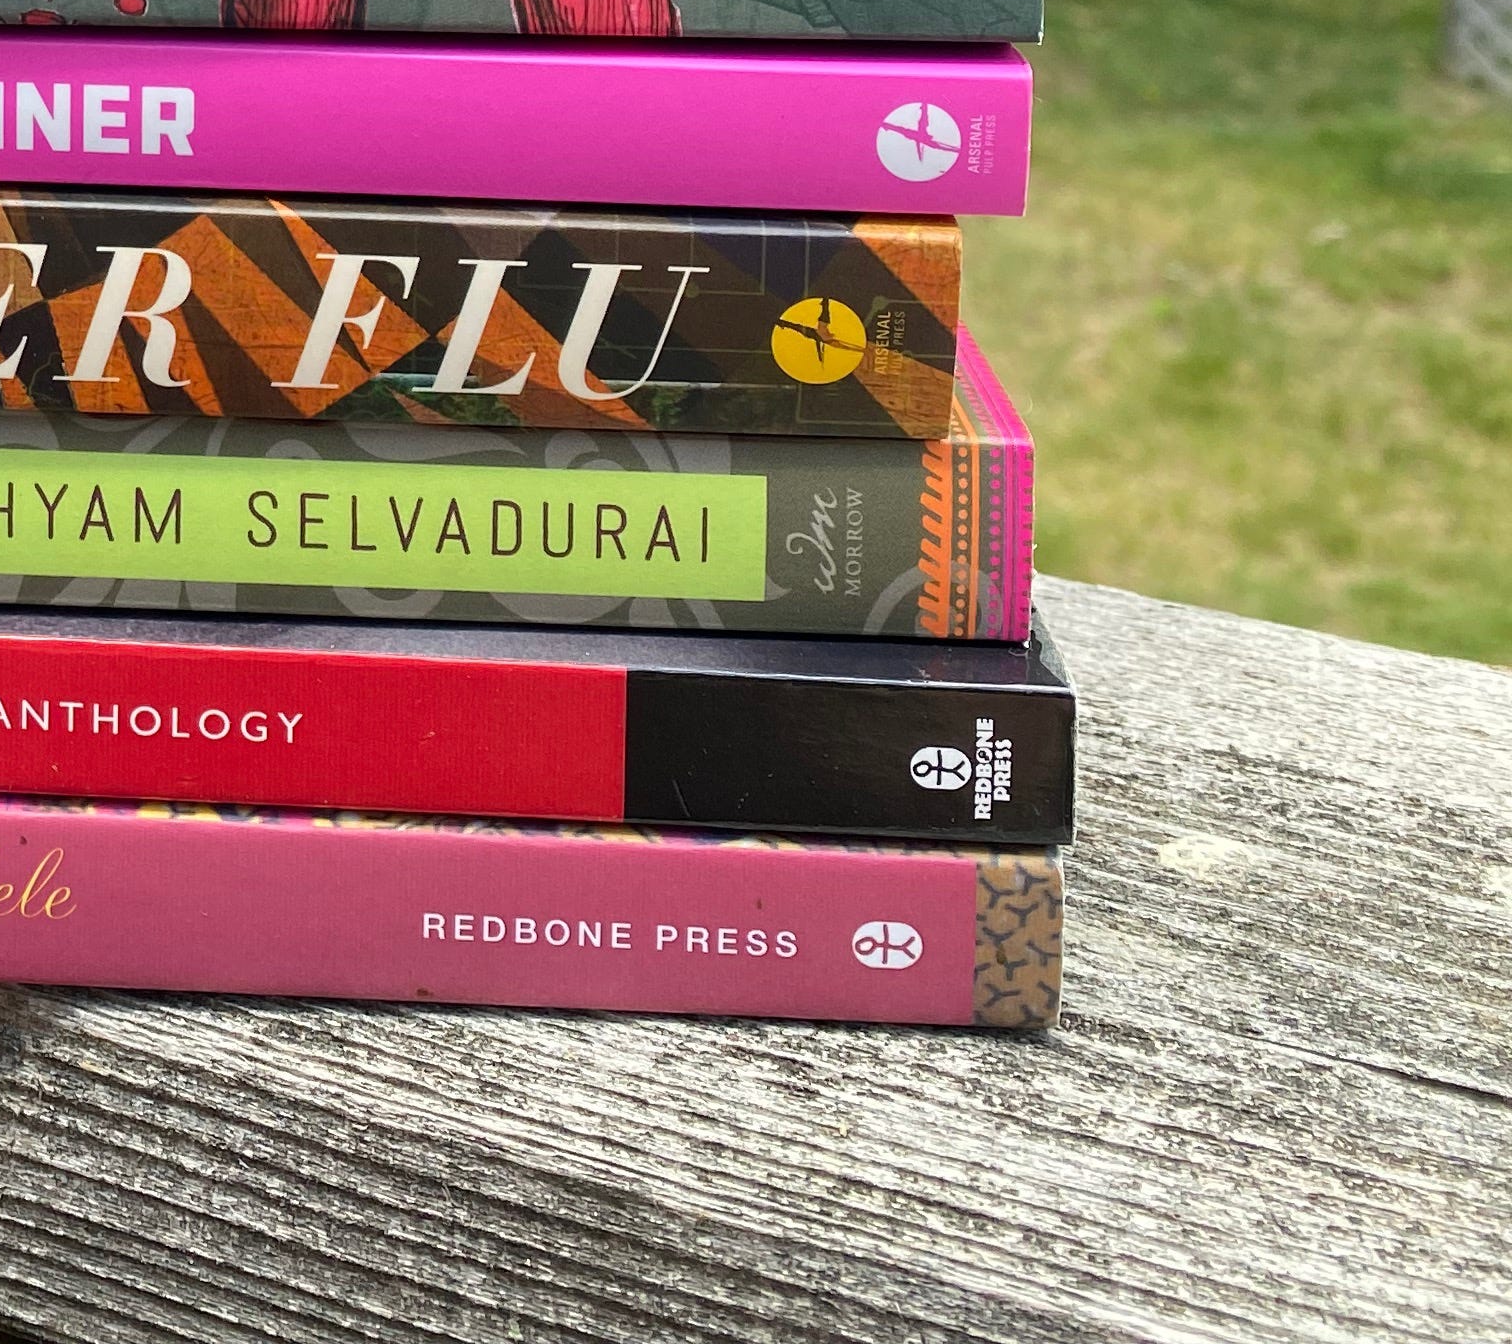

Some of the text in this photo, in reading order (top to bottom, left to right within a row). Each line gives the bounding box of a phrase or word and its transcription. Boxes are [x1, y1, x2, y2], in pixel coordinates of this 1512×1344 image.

[968, 114, 984, 174] ARSENAL
[270, 253, 712, 401] FLU
[874, 311, 891, 375] ARSENAL
[893, 311, 906, 346] PRESS
[246, 489, 710, 566] SELVADURAI
[844, 487, 863, 597] MORROW
[974, 718, 994, 820] REDBONE
[993, 738, 1012, 801] PRESS
[422, 912, 799, 958] REDBONE PRESS
